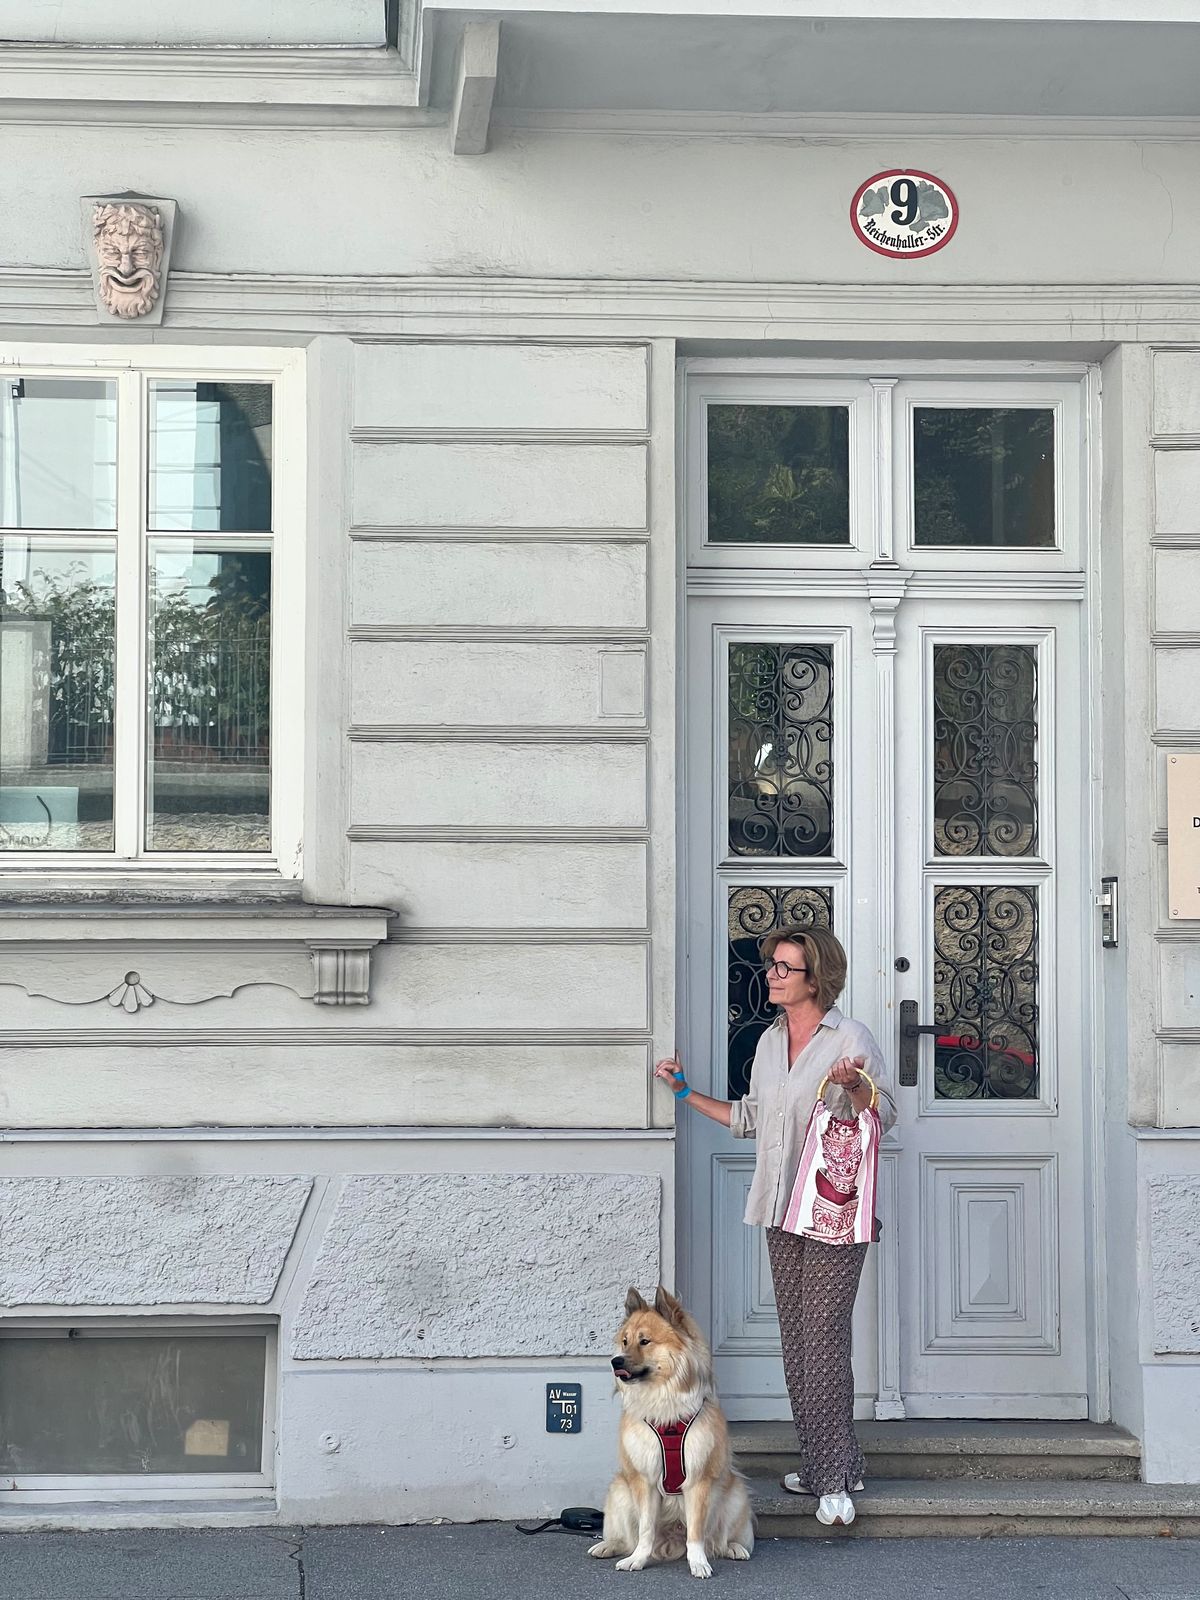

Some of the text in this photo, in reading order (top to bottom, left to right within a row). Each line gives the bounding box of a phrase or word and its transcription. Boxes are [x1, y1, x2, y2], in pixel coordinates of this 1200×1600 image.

[890, 178, 918, 226] 9
[549, 1389, 561, 1399] AV
[560, 1418, 573, 1429] 73
